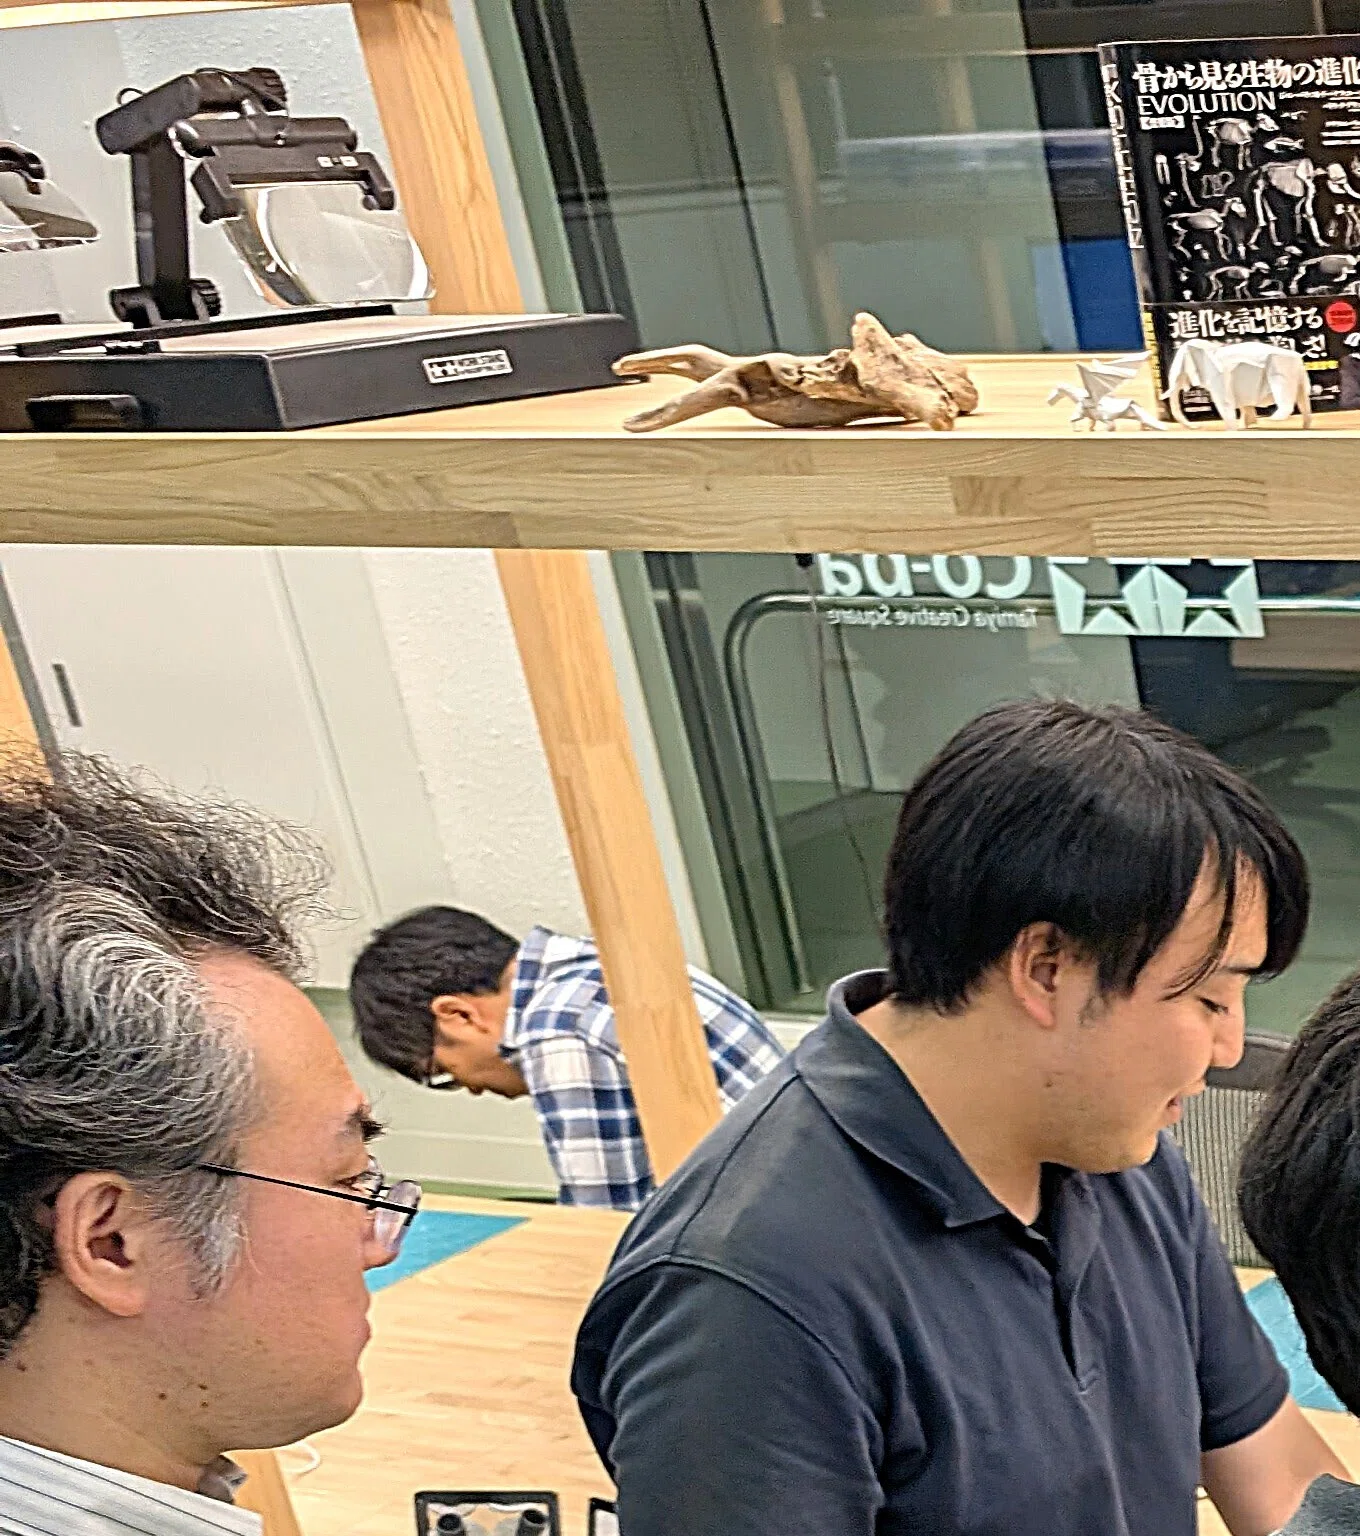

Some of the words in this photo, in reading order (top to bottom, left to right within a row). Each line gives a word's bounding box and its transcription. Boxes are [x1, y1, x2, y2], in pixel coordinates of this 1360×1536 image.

[1137, 91, 1277, 116] EVOLUTION
[1169, 306, 1324, 339] 進化を記憶する
